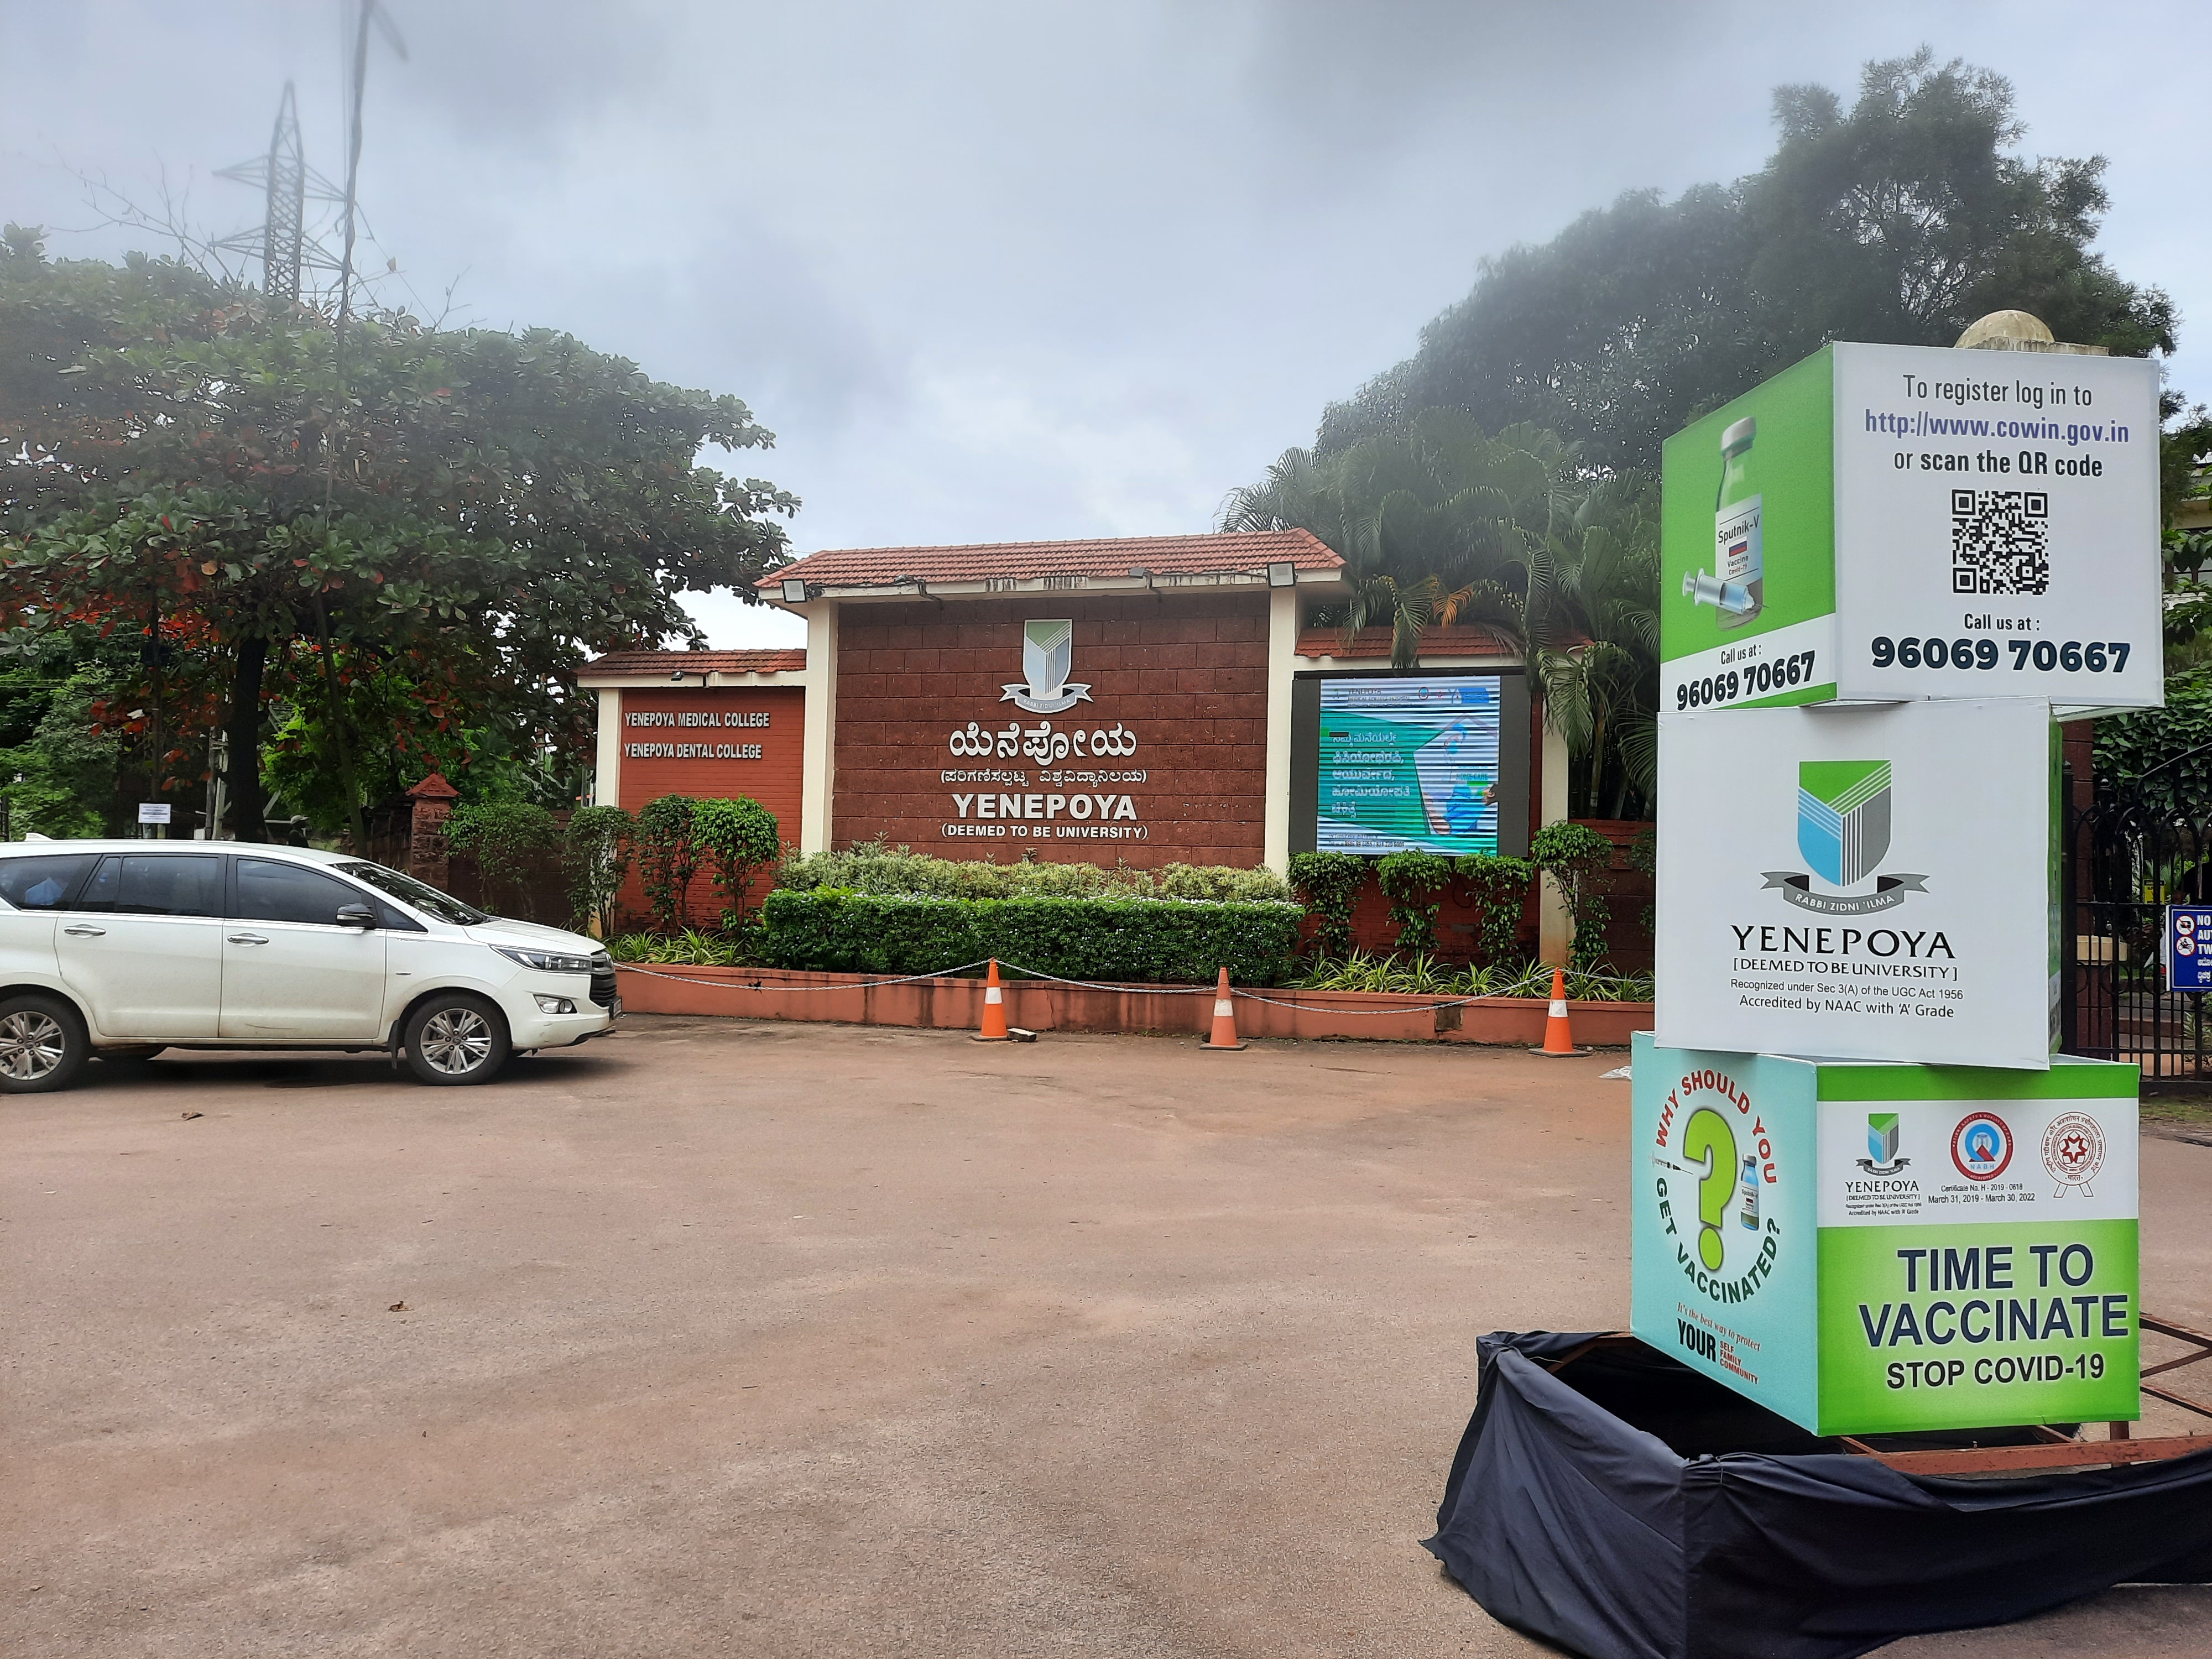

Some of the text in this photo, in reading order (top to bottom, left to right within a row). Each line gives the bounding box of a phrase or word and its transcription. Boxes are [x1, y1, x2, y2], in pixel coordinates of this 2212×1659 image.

[1903, 375, 2092, 409] To register log in to
[1865, 409, 2129, 446] http://www.cowin.gov.in
[1894, 450, 2102, 477] or scan the QR code
[1718, 514, 1759, 545] Sputnik-V
[1728, 555, 1749, 568] Vaccine
[1964, 614, 1991, 630] Call
[1996, 618, 2012, 630] us
[2017, 616, 2031, 630] at
[1721, 647, 1735, 665] Call
[1738, 648, 1746, 660] us
[1749, 644, 1757, 657] at
[1871, 637, 2130, 672] 96069 70667
[1677, 650, 1815, 711] 96069 70667
[625, 712, 770, 727] YENEPOYA MEDICAL COLLEGE
[624, 742, 761, 758] YENEPOYA DENTAL COLLEGE
[952, 794, 1137, 820] YENEPOYA
[941, 822, 1149, 841] (DEEMED TO BE UNIVERSITY)
[1795, 893, 1826, 909] RABBI
[1829, 902, 1860, 911] ZIDNI
[2197, 915, 2211, 926] NO
[1730, 925, 1957, 959] YENEPOYA
[2197, 930, 2212, 941] AU
[1807, 961, 1828, 973] TO
[1831, 962, 1850, 974] BE
[1731, 978, 1963, 1000] Recognized under Sec 3(A) of the UGC Act 1956
[1739, 994, 1802, 1009] Accredited
[1807, 998, 1820, 1013] by
[1825, 999, 1861, 1013] NAAC
[1866, 1001, 1893, 1014] with
[1915, 1004, 1954, 1018] Grade
[1656, 1068, 1777, 1184] WHY SHOULD YOU
[1845, 1181, 1919, 1192] YENEPOYA
[1928, 1194, 1949, 1203] March
[1950, 1195, 1961, 1204] 31,
[1963, 1194, 1979, 1202] 2019
[1985, 1193, 2005, 1202] March
[2007, 1193, 2017, 1202] 30,
[2019, 1193, 2036, 1202] 2022
[1656, 1177, 1781, 1305] GET VACCINATED?
[1897, 1244, 2093, 1292] TIME TO
[1689, 1308, 1699, 1321] the
[1700, 1313, 1713, 1328] best
[1714, 1323, 1726, 1337] way
[1728, 1329, 1735, 1339] to
[1736, 1333, 1760, 1352] protect
[1859, 1295, 2128, 1347] VACCINATE
[1677, 1318, 1716, 1363] YOUR
[1720, 1340, 1734, 1353] SELF
[1720, 1349, 1741, 1366] FAMILY
[1720, 1359, 1758, 1384] COMMUNITY
[1887, 1353, 2104, 1389] STOP COVID-19
